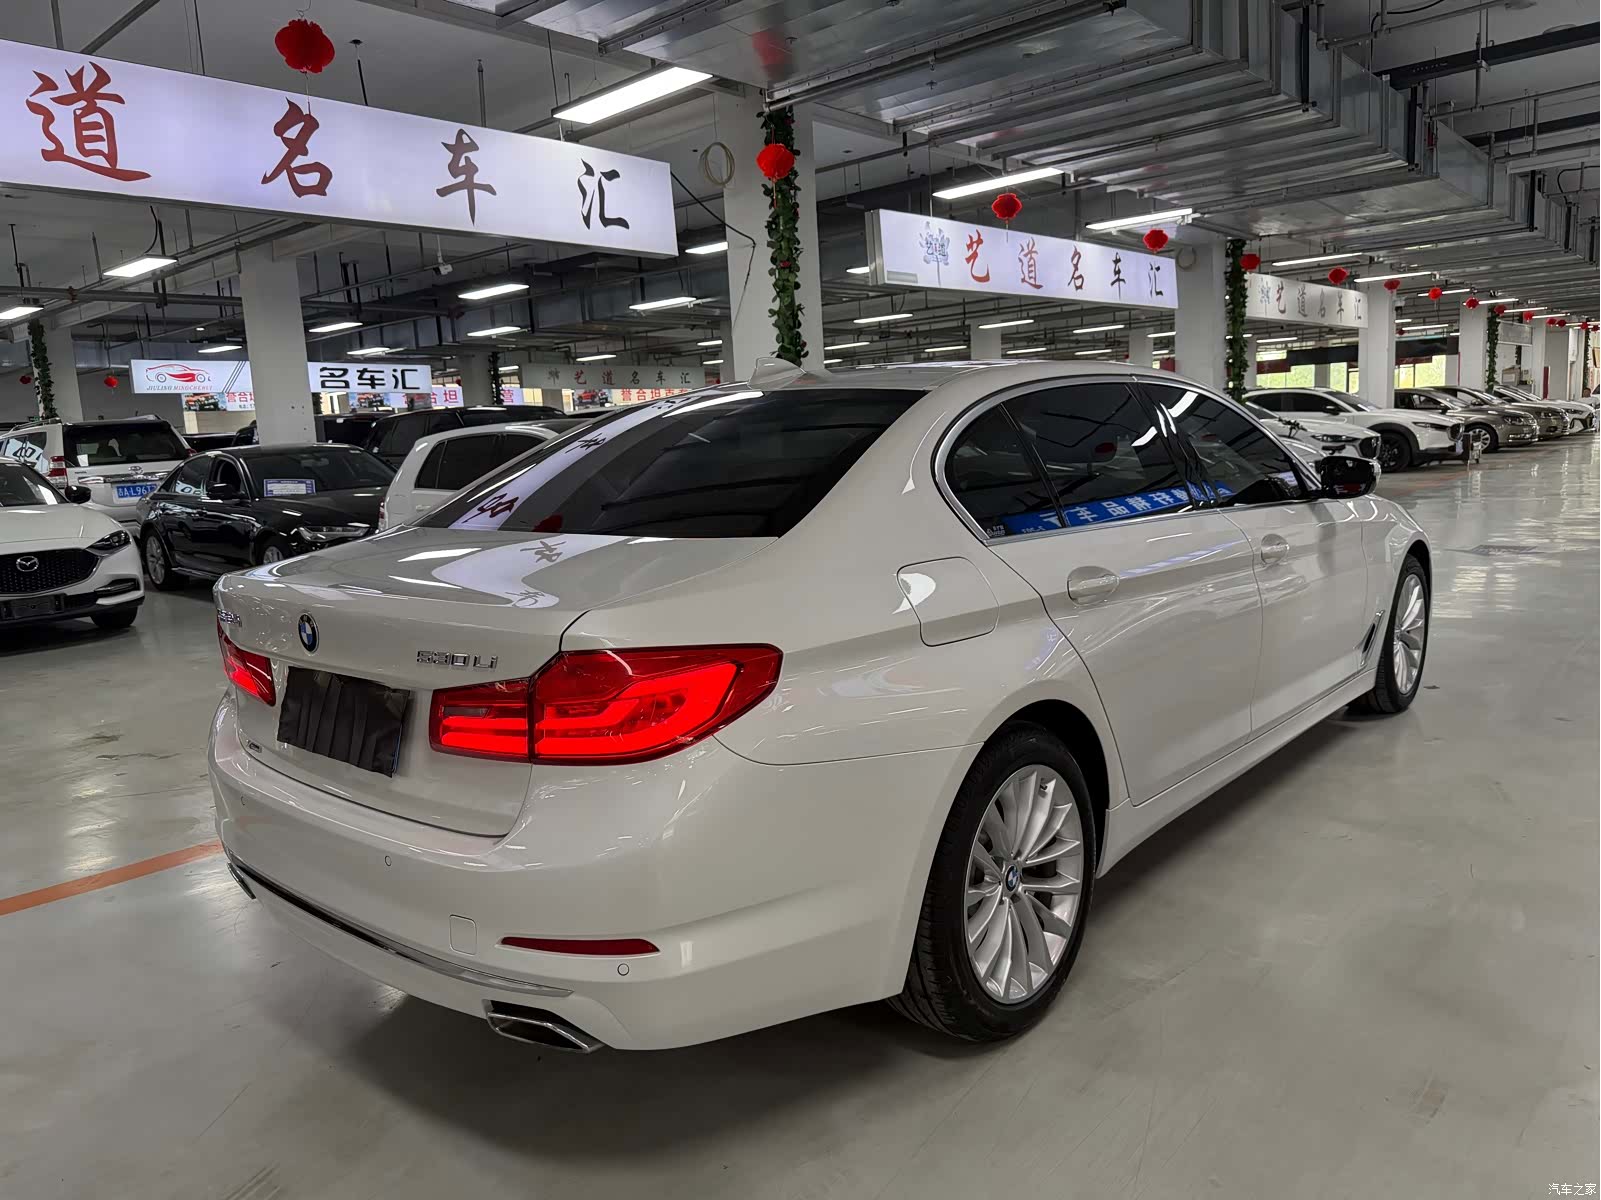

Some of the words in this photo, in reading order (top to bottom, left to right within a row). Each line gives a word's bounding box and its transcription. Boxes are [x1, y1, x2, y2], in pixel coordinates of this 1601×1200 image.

[964, 229, 1164, 300] 艺道名车汇
[319, 366, 420, 390] 名车汇
